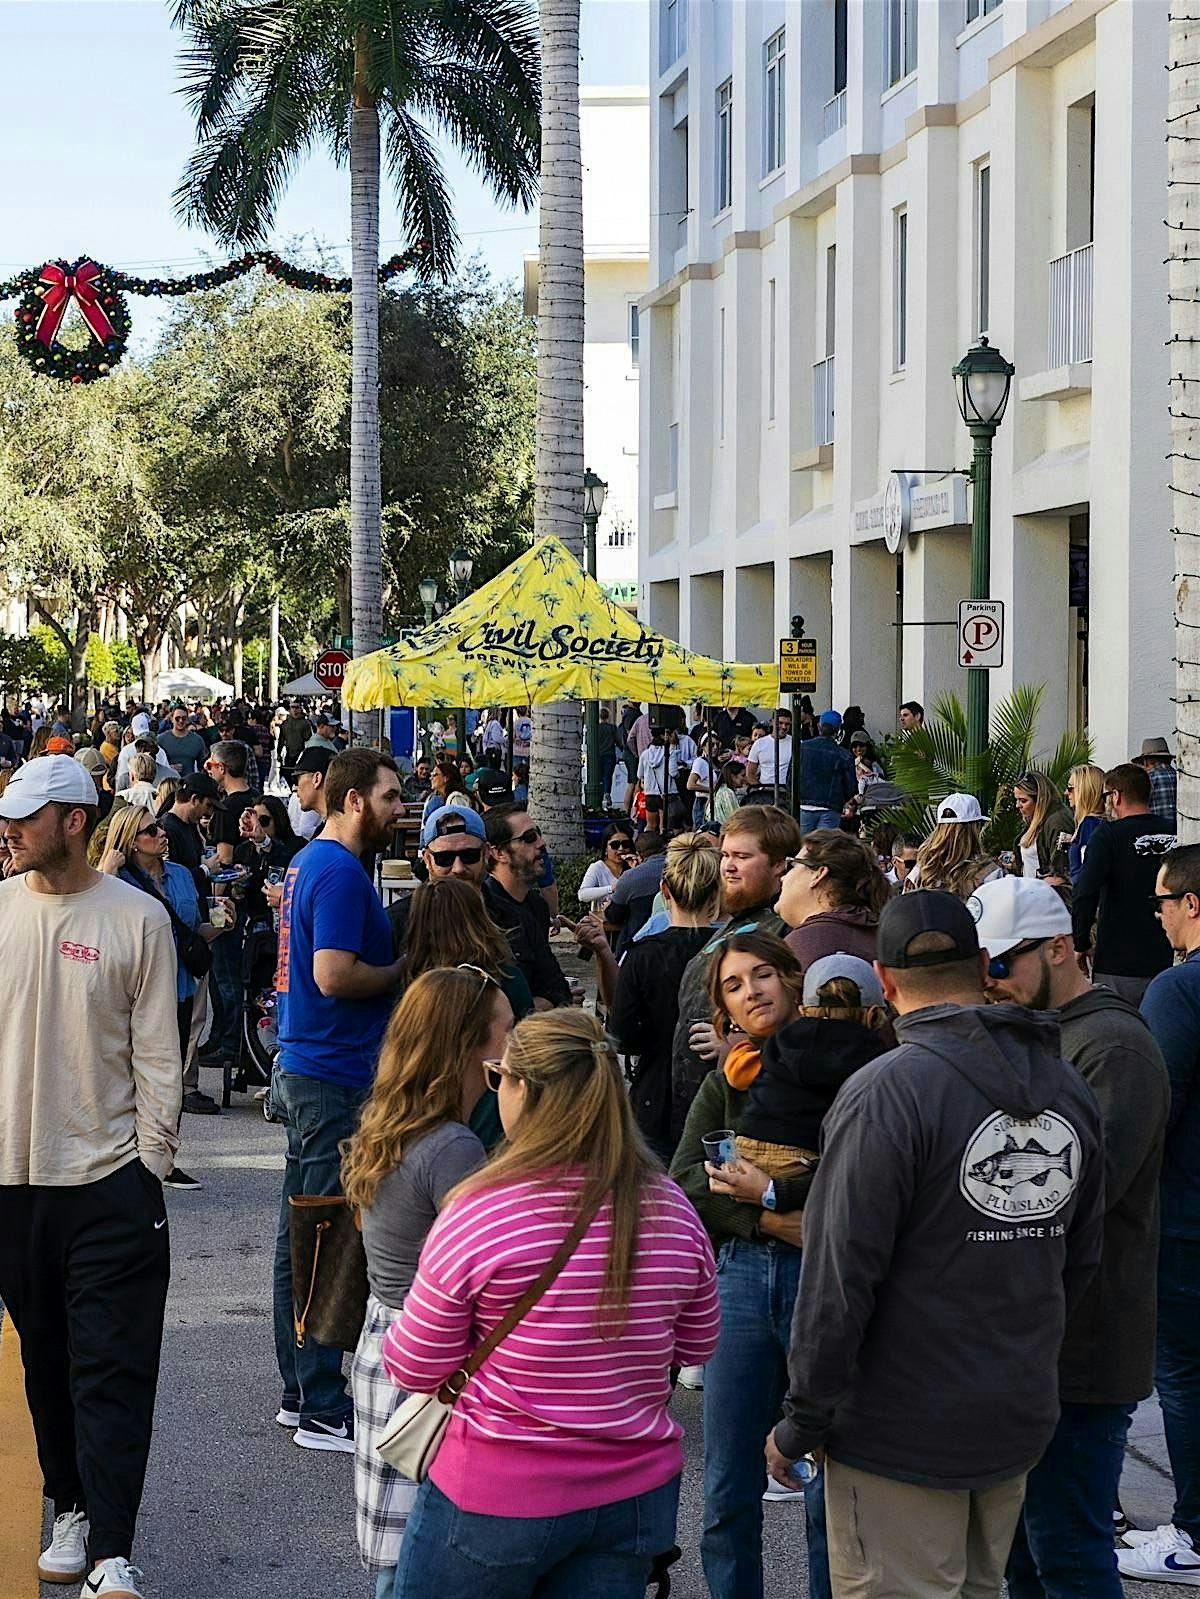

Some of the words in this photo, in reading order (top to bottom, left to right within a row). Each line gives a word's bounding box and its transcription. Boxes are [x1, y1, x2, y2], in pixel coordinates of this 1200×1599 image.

[967, 604, 996, 612] Parking
[973, 622, 993, 645] P
[457, 619, 540, 656] Civil
[539, 624, 664, 663] Society
[786, 642, 794, 653] 3
[965, 1230, 1015, 1242] FISHING
